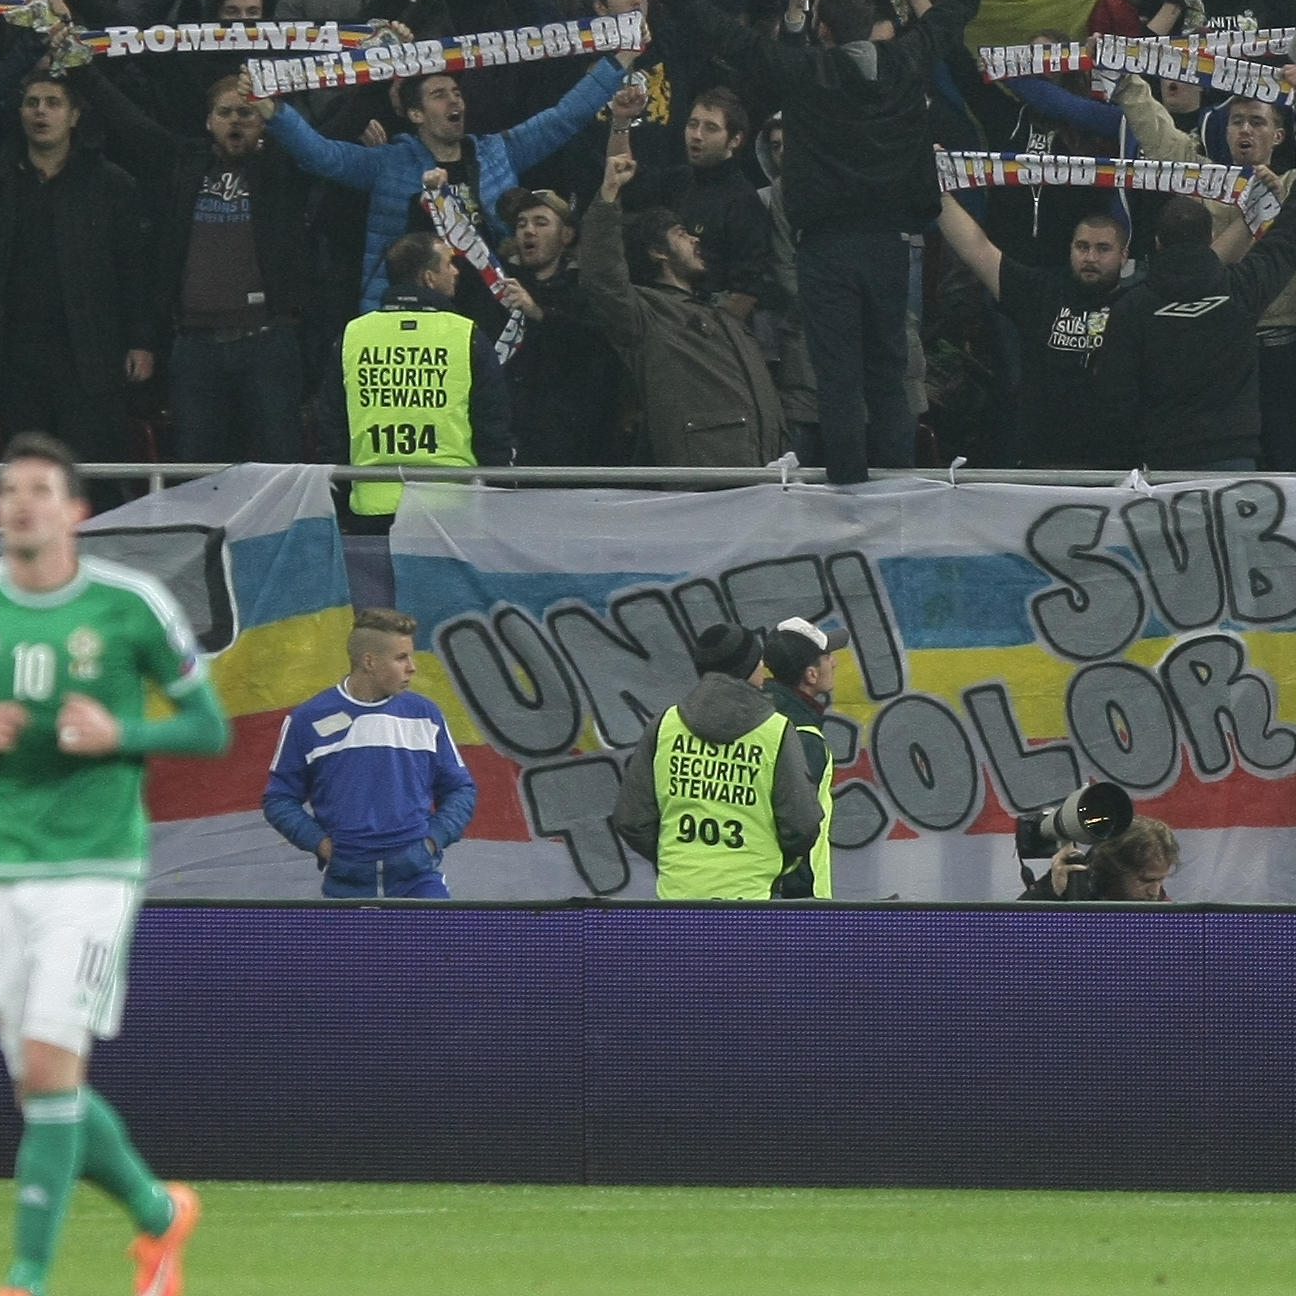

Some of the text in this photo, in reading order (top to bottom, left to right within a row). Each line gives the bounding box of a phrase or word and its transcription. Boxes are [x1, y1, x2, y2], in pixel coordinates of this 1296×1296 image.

[105, 21, 343, 57] ROMANIA
[248, 10, 643, 98] UNITI SUB TRICOLOR
[1017, 153, 1096, 186] SUB
[357, 346, 448, 365] ALISTAR
[357, 367, 447, 387] SECURITY
[359, 388, 447, 408] STEWARD
[366, 423, 438, 454] 1134
[13, 642, 56, 702] 10
[670, 734, 763, 765] ALISTAR
[669, 755, 759, 785] SECURITY
[668, 777, 757, 806] STEWARD
[676, 814, 744, 848] 903
